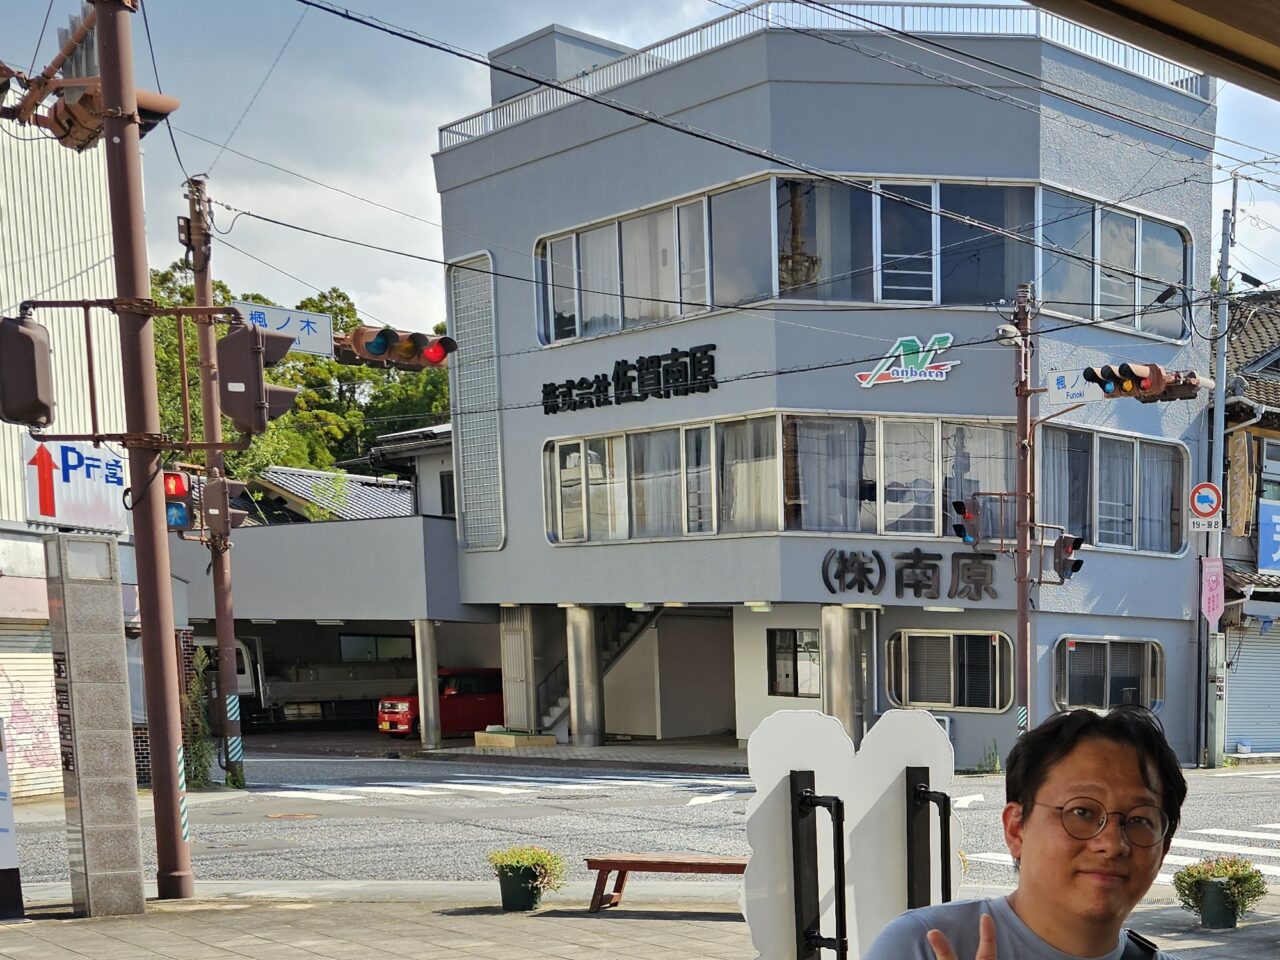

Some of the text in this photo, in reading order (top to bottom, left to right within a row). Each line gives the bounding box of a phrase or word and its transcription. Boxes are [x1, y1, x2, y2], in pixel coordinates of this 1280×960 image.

[542, 343, 718, 415] 株式会社佐賀南原
[1066, 390, 1085, 400] Funoki
